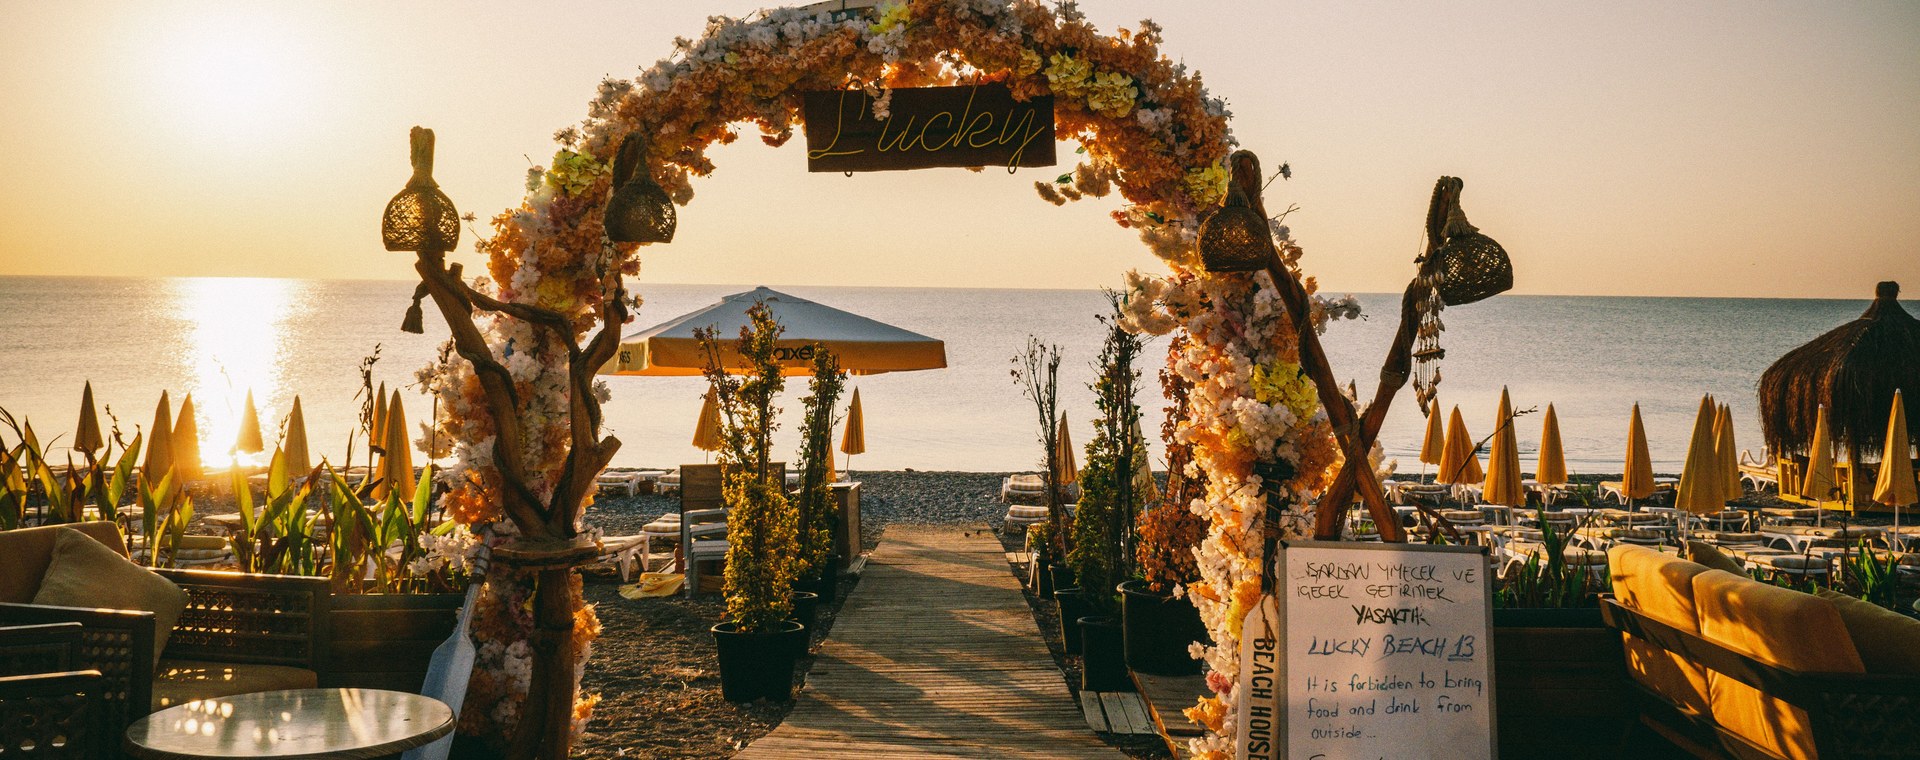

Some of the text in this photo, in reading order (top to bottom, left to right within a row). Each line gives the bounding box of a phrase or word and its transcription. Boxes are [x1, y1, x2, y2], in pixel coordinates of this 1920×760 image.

[808, 76, 1045, 174] Lucky
[1453, 568, 1475, 583] VE
[1308, 634, 1475, 660] LUCKY BEACH 13
[1252, 638, 1275, 699] BEACH
[1307, 670, 1482, 696] It is forbidden to bring
[1307, 696, 1472, 719] food and drink from
